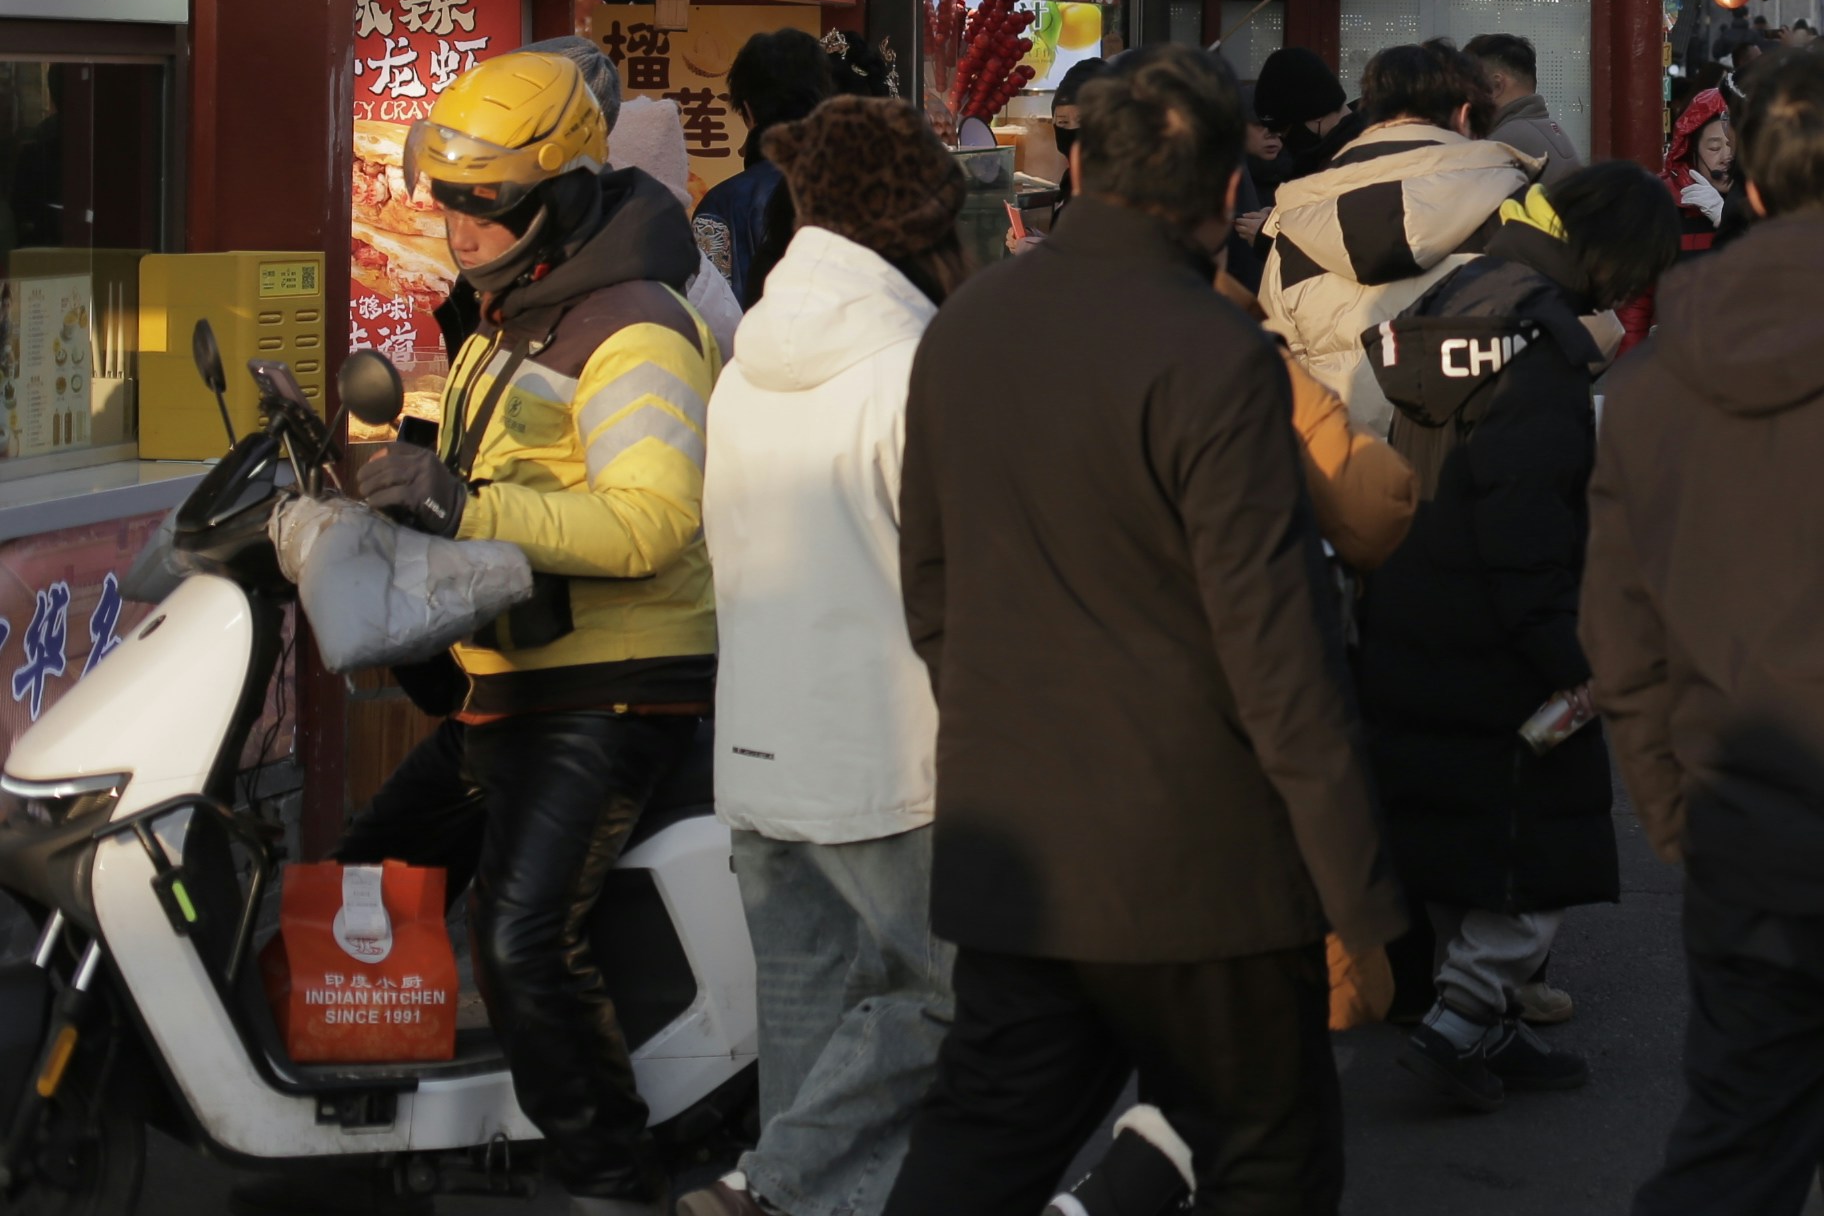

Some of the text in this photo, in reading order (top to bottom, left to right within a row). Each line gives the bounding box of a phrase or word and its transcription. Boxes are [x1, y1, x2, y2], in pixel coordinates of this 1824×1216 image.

[355, 36, 490, 99] 龙虾
[324, 973, 424, 989] 印度小厨
[306, 990, 446, 1005] INDIAN KITCHEN
[325, 1010, 422, 1024] SINCE 1991
